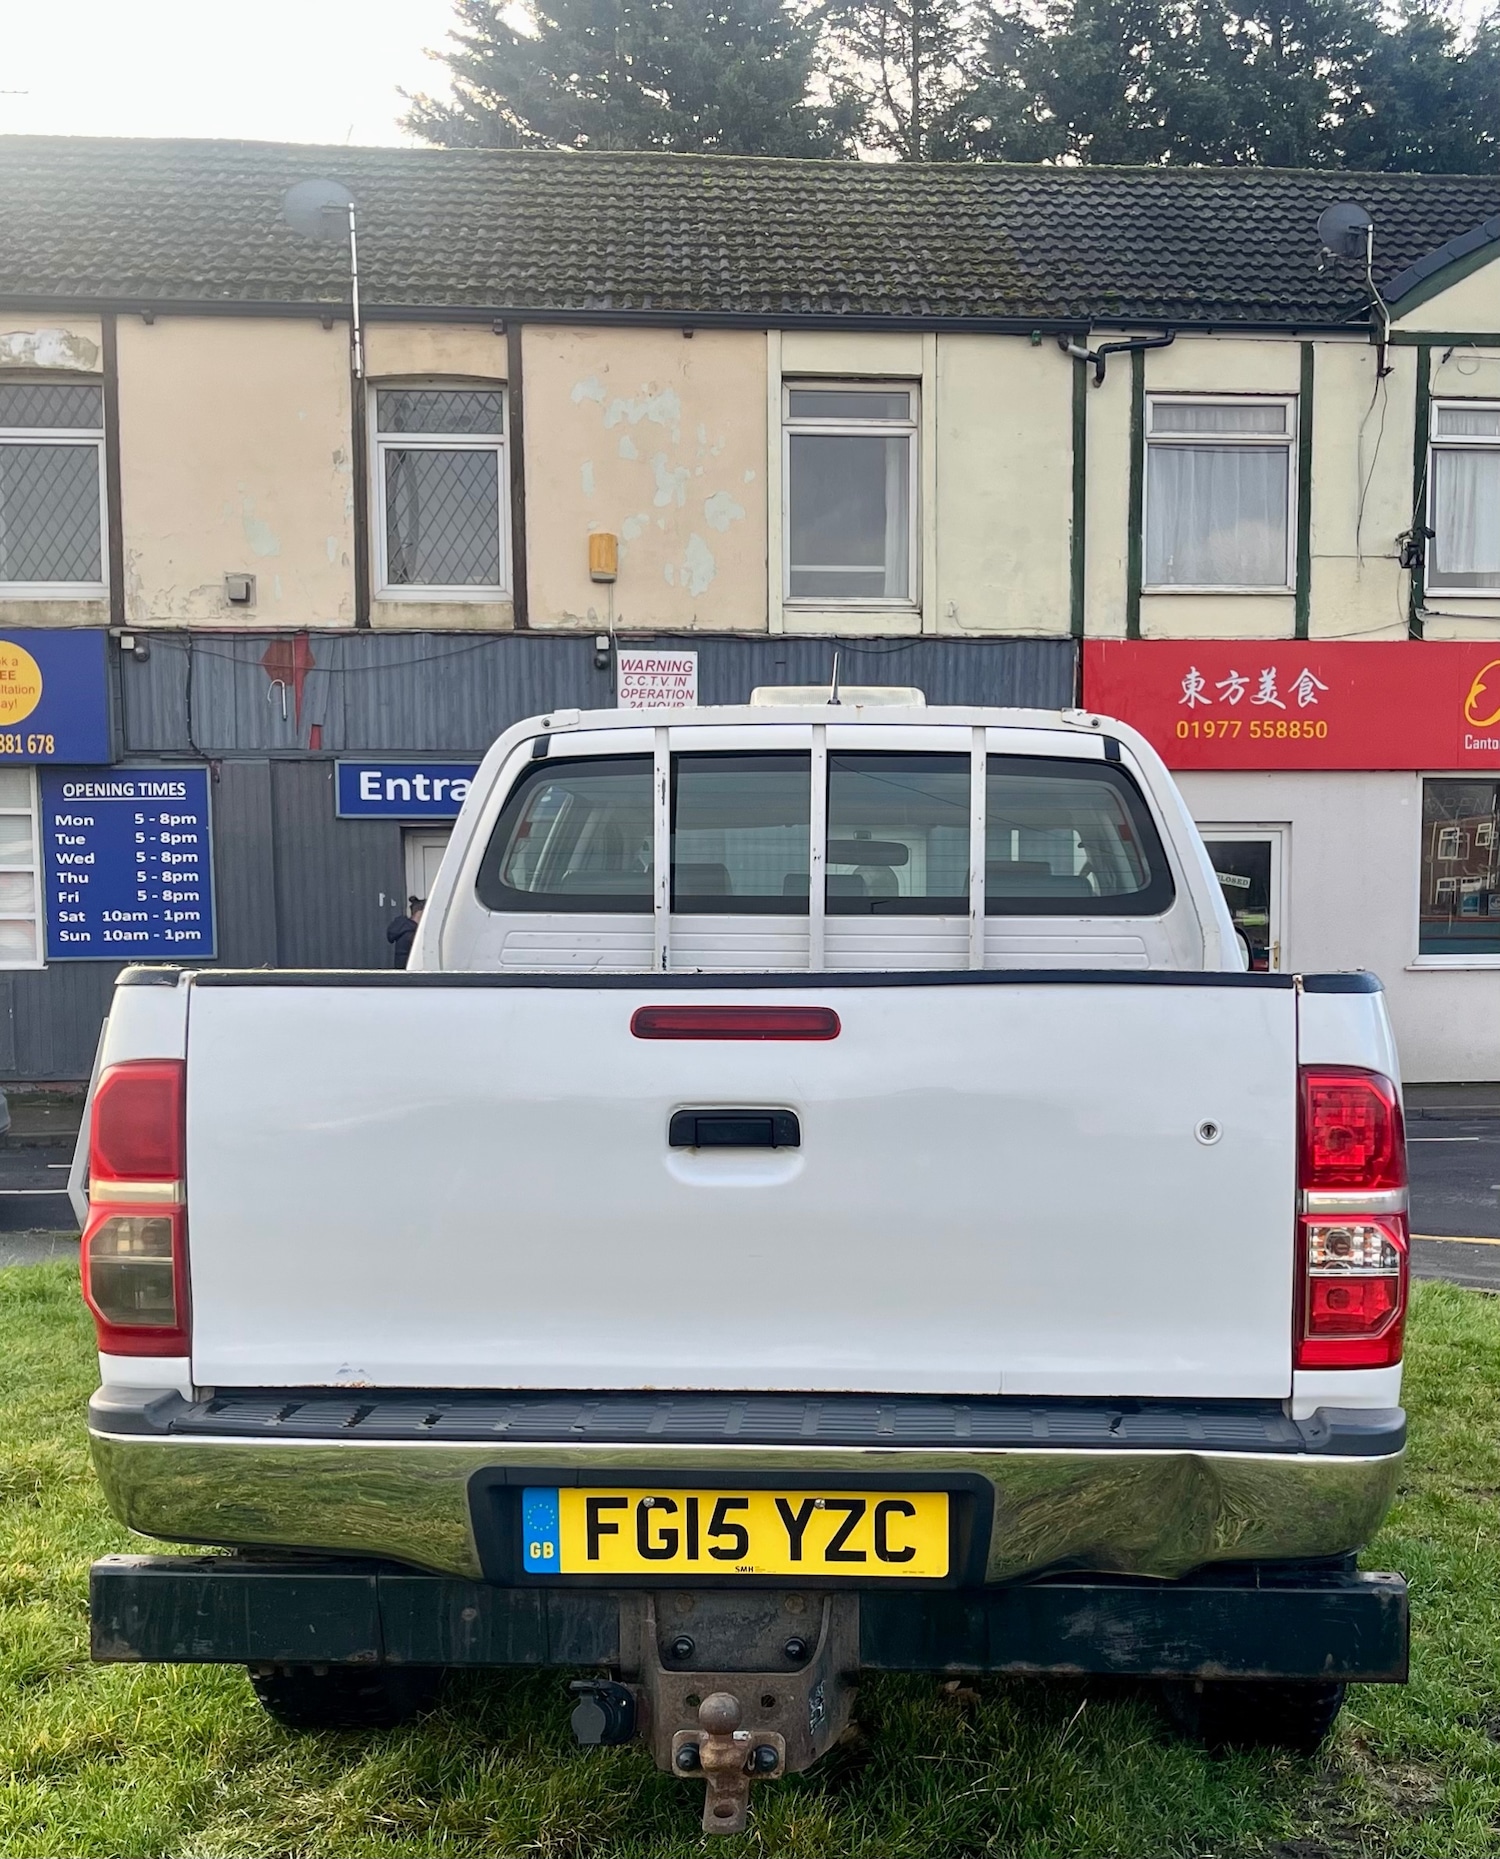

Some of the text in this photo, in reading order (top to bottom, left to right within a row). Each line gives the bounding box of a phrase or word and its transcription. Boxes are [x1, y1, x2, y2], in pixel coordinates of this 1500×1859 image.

[621, 659, 694, 672] WARNING
[674, 677, 687, 687] IN
[1178, 666, 1329, 710] 東方美食
[620, 688, 694, 700] OPERATION
[1176, 720, 1328, 739] 01977 558850
[27, 734, 55, 754] 678
[63, 782, 186, 797] OPENING TIMES
[360, 771, 472, 801] Entra
[55, 815, 94, 826] Mon
[134, 813, 144, 824] 5
[160, 813, 197, 827] 8pm
[55, 833, 86, 845] Tue
[135, 832, 145, 843] 5
[160, 832, 197, 845] 8pm
[56, 852, 95, 864] Wed
[136, 851, 146, 863] 5
[161, 851, 198, 865] 8pm
[57, 872, 89, 883] Thu
[137, 871, 147, 882] 5
[162, 871, 199, 884] 8pm
[58, 891, 79, 902] Fri
[137, 890, 147, 901] 5
[162, 890, 200, 903] 8pm
[58, 911, 86, 922] Sat
[102, 910, 148, 922] 10am
[164, 909, 200, 922] 1pm
[59, 930, 91, 941] Sun
[103, 930, 149, 941] 10am
[165, 929, 201, 942] 1pm
[586, 1497, 916, 1562] FG15 YZC
[530, 1541, 554, 1559] GB
